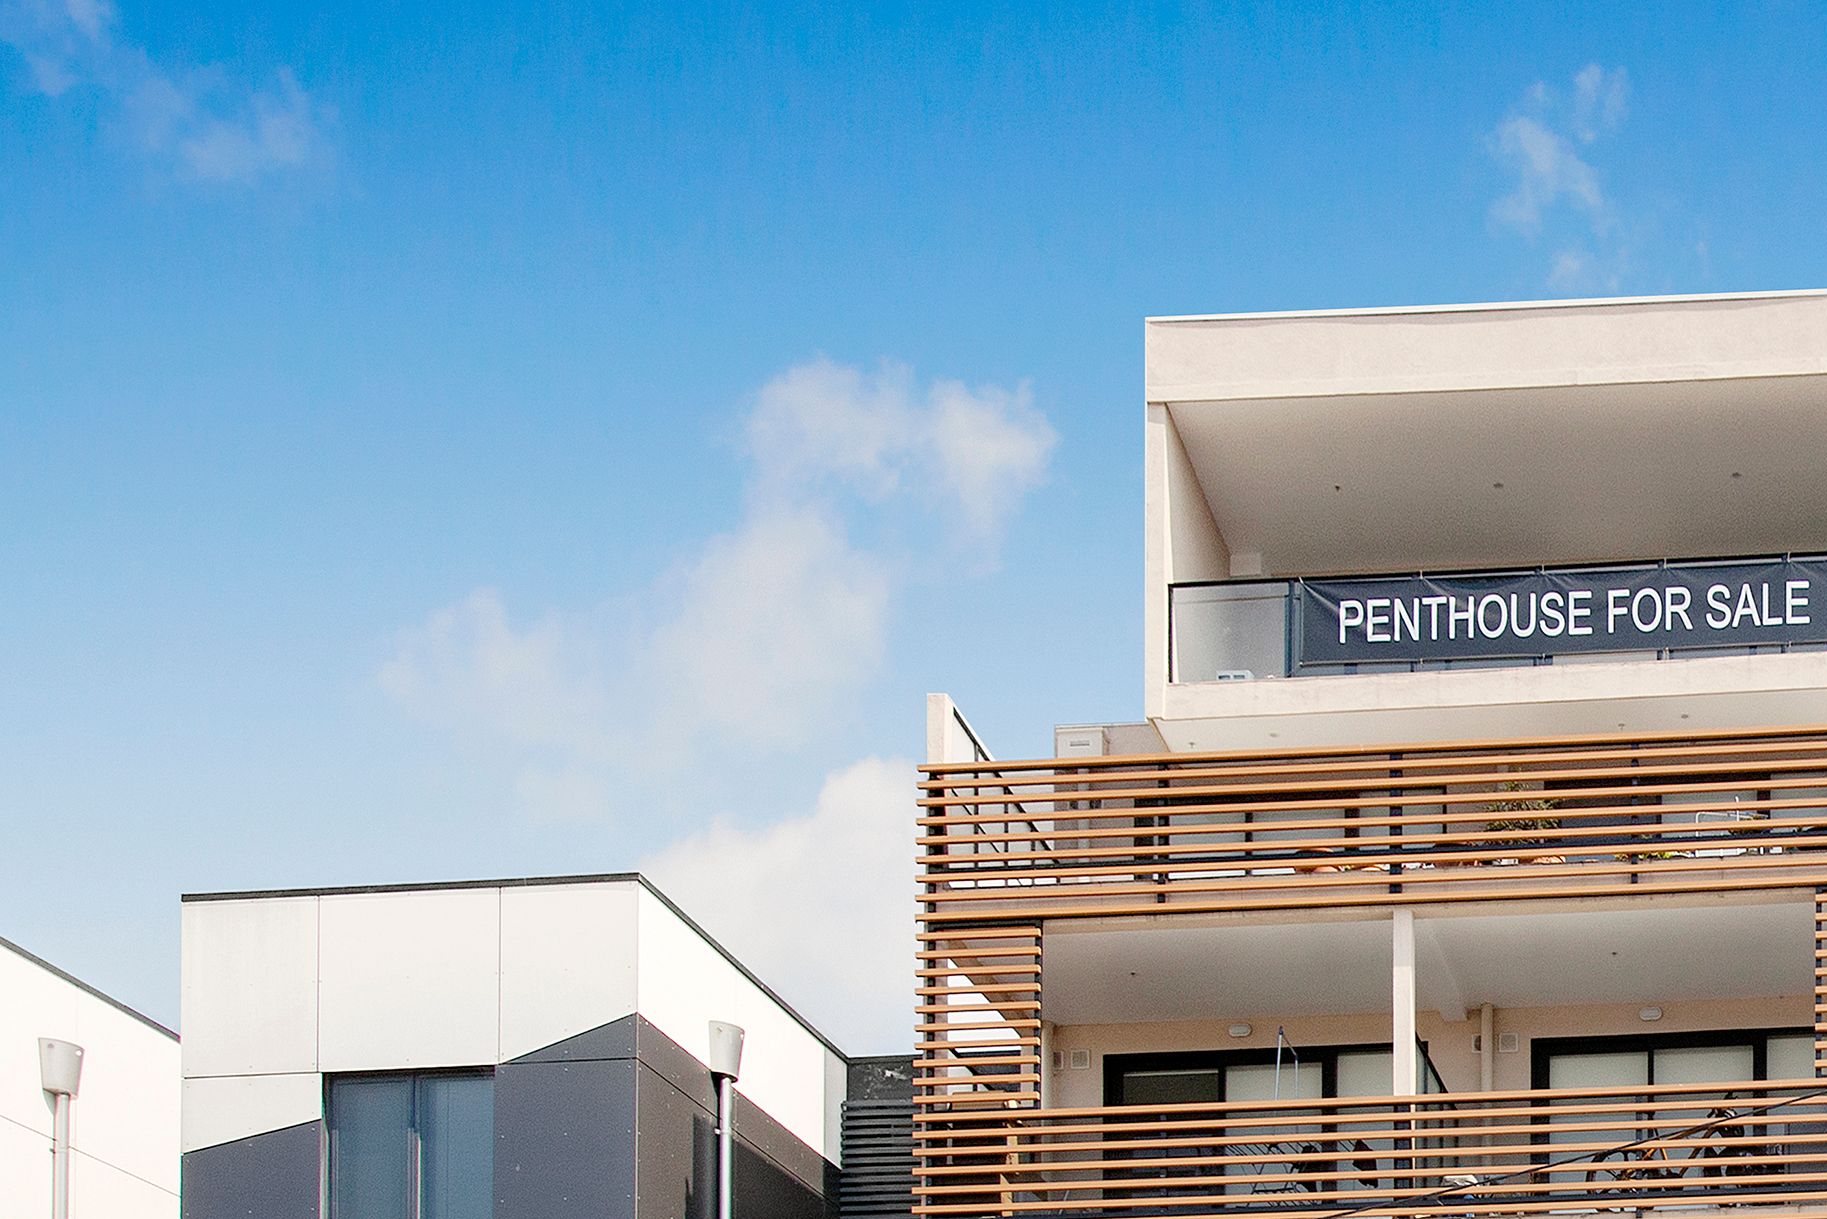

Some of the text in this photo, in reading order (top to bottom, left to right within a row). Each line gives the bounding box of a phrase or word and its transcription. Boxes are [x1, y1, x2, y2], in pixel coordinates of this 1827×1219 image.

[1338, 580, 1811, 645] PENTHOUSE FOR SALE
